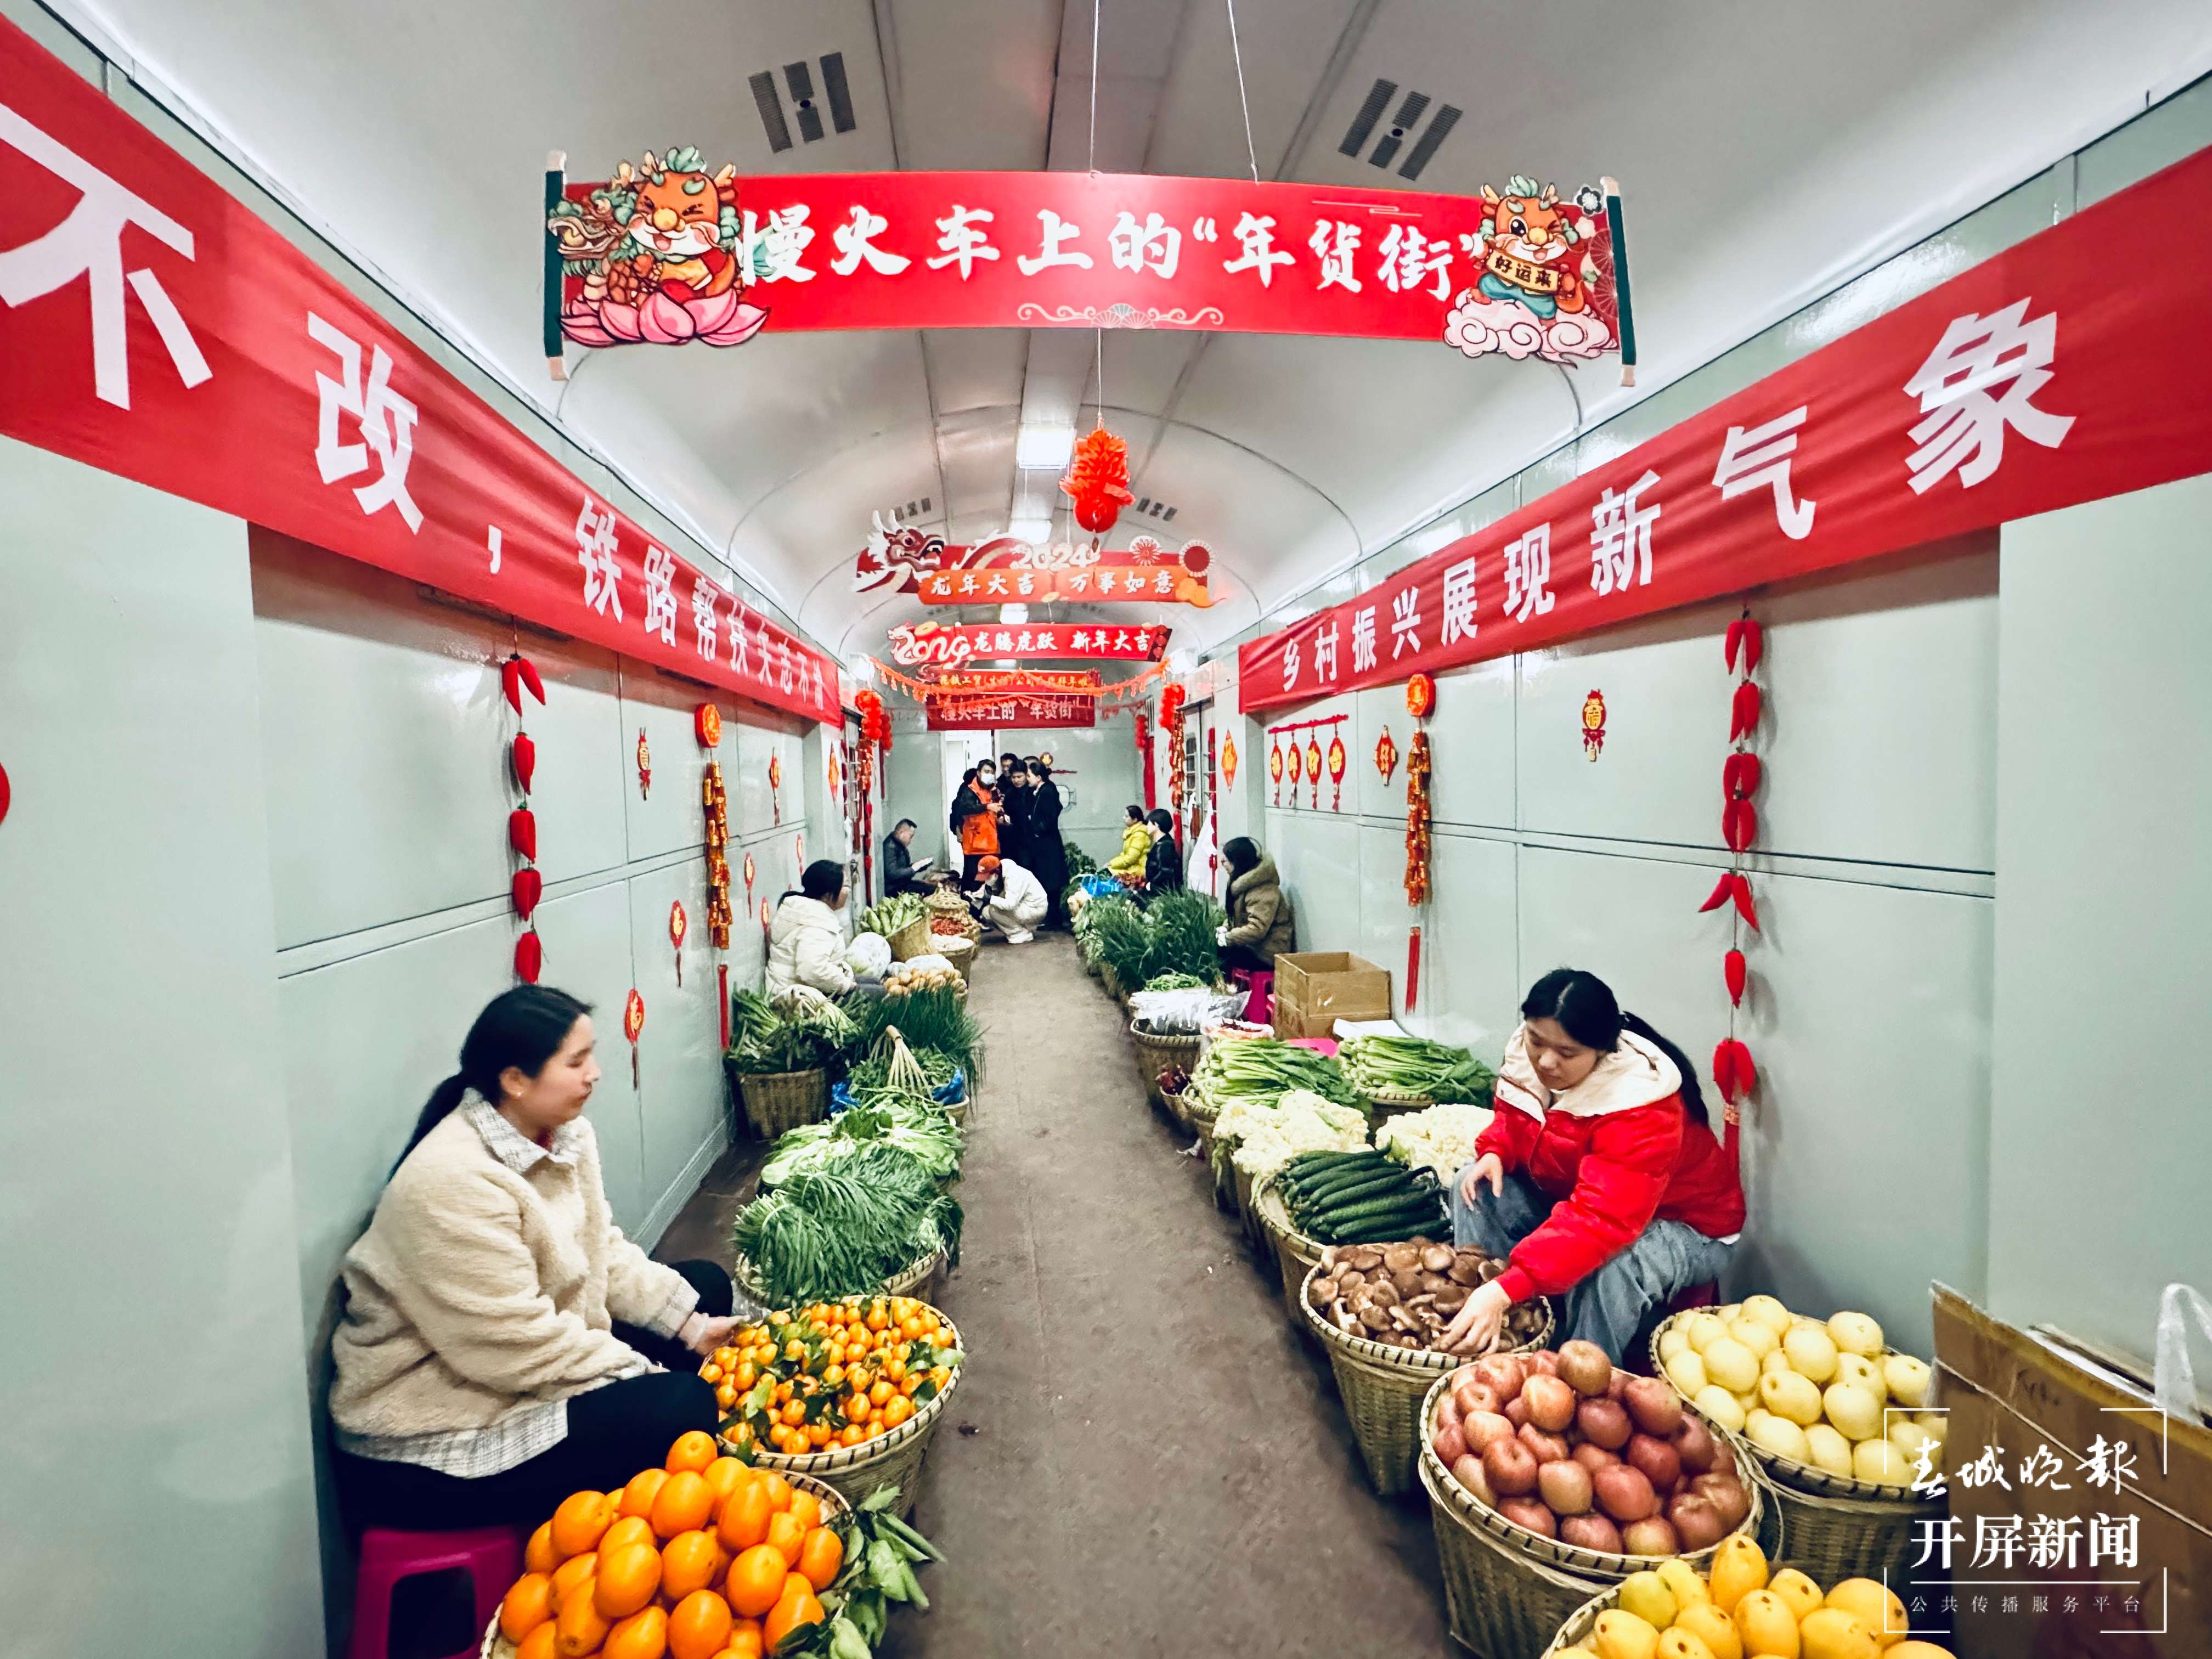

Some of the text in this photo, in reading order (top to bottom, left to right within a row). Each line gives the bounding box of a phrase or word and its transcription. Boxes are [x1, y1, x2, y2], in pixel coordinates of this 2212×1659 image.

[1494, 255, 1552, 287] 好运来
[1282, 297, 2076, 692] 乡村振兴展现新气象
[1012, 544, 1096, 569] 2024
[930, 569, 1175, 597] 龙年大吉 万事如意
[974, 631, 1058, 653] 龙腾虎跃
[1070, 629, 1152, 654] 新年大吉
